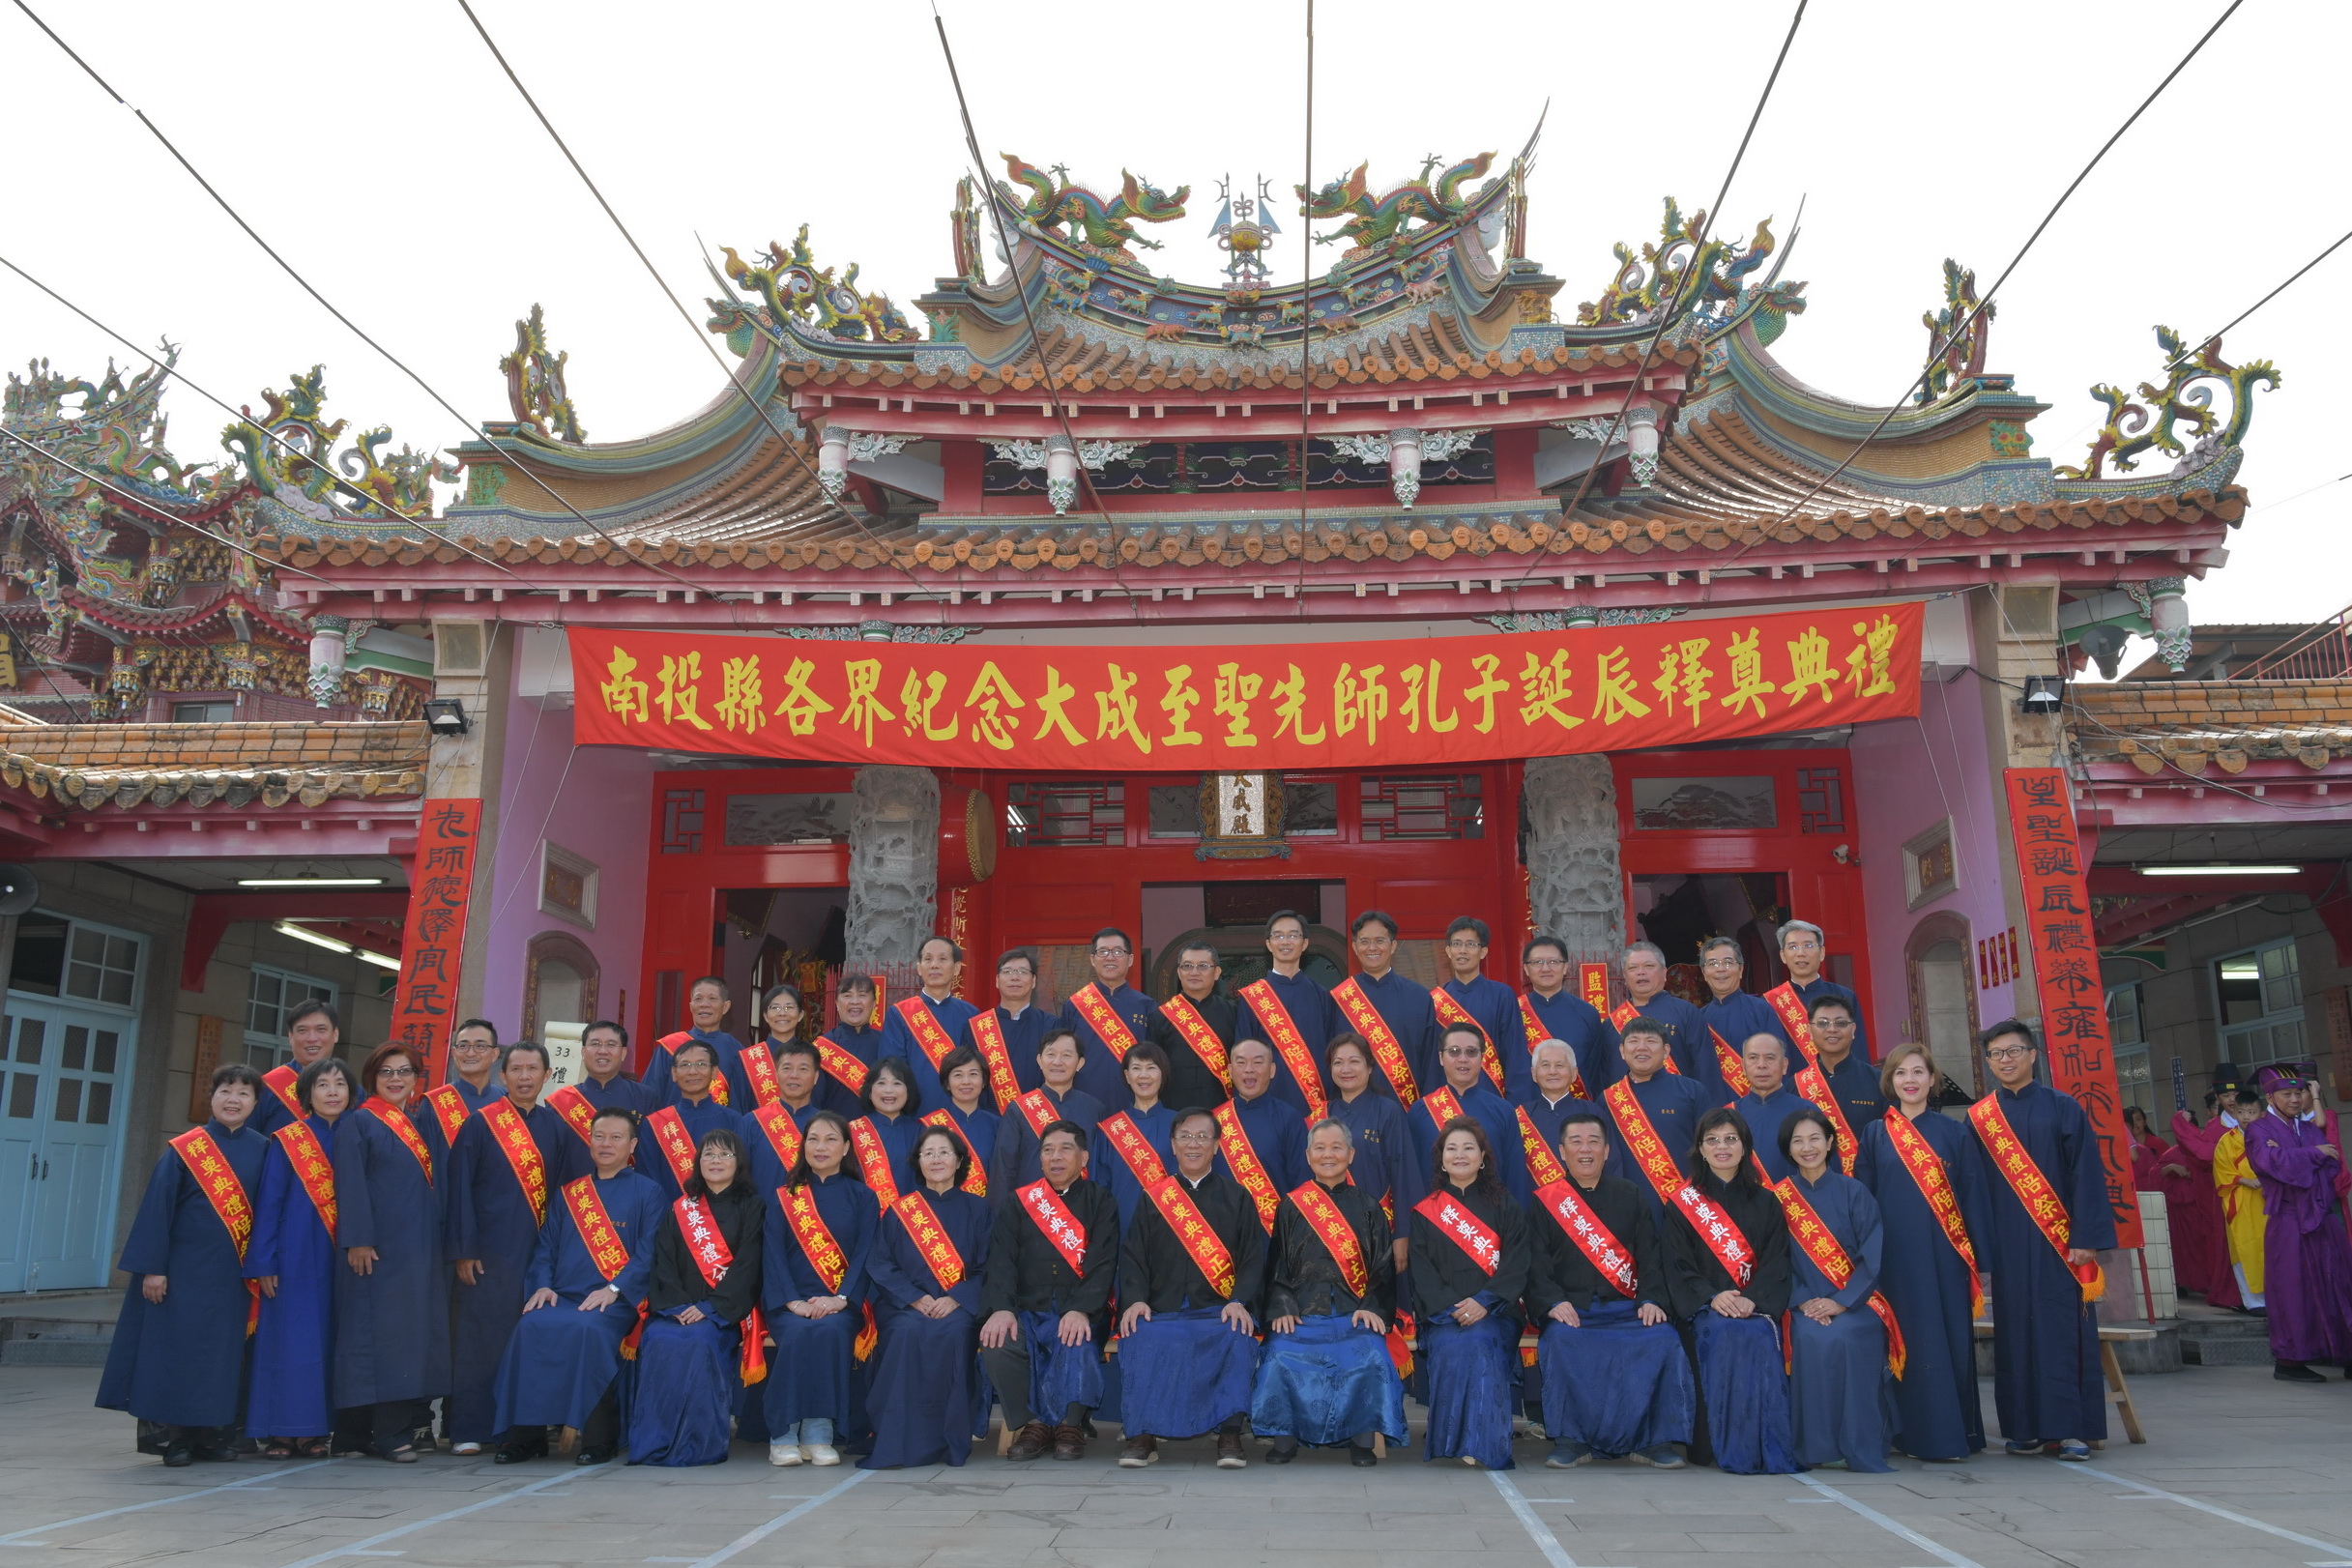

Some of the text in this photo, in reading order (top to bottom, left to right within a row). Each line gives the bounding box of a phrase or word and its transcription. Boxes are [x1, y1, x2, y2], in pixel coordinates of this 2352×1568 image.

[600, 613, 1898, 754] 南投縣各界紀念大成至聖先師孔子誕辰釋奠典禮
[1340, 985, 1415, 1105] 釋奠典禮陪祭官
[1587, 971, 1606, 1022] 監禮
[552, 1066, 567, 1084] 禮
[555, 1046, 570, 1058] 33
[1217, 1108, 1279, 1230] 釋奠典禮陪祭
[1977, 1099, 2070, 1244] 釋奠典禮陪祭官
[1774, 1184, 1849, 1283] 釋奠典禮陪
